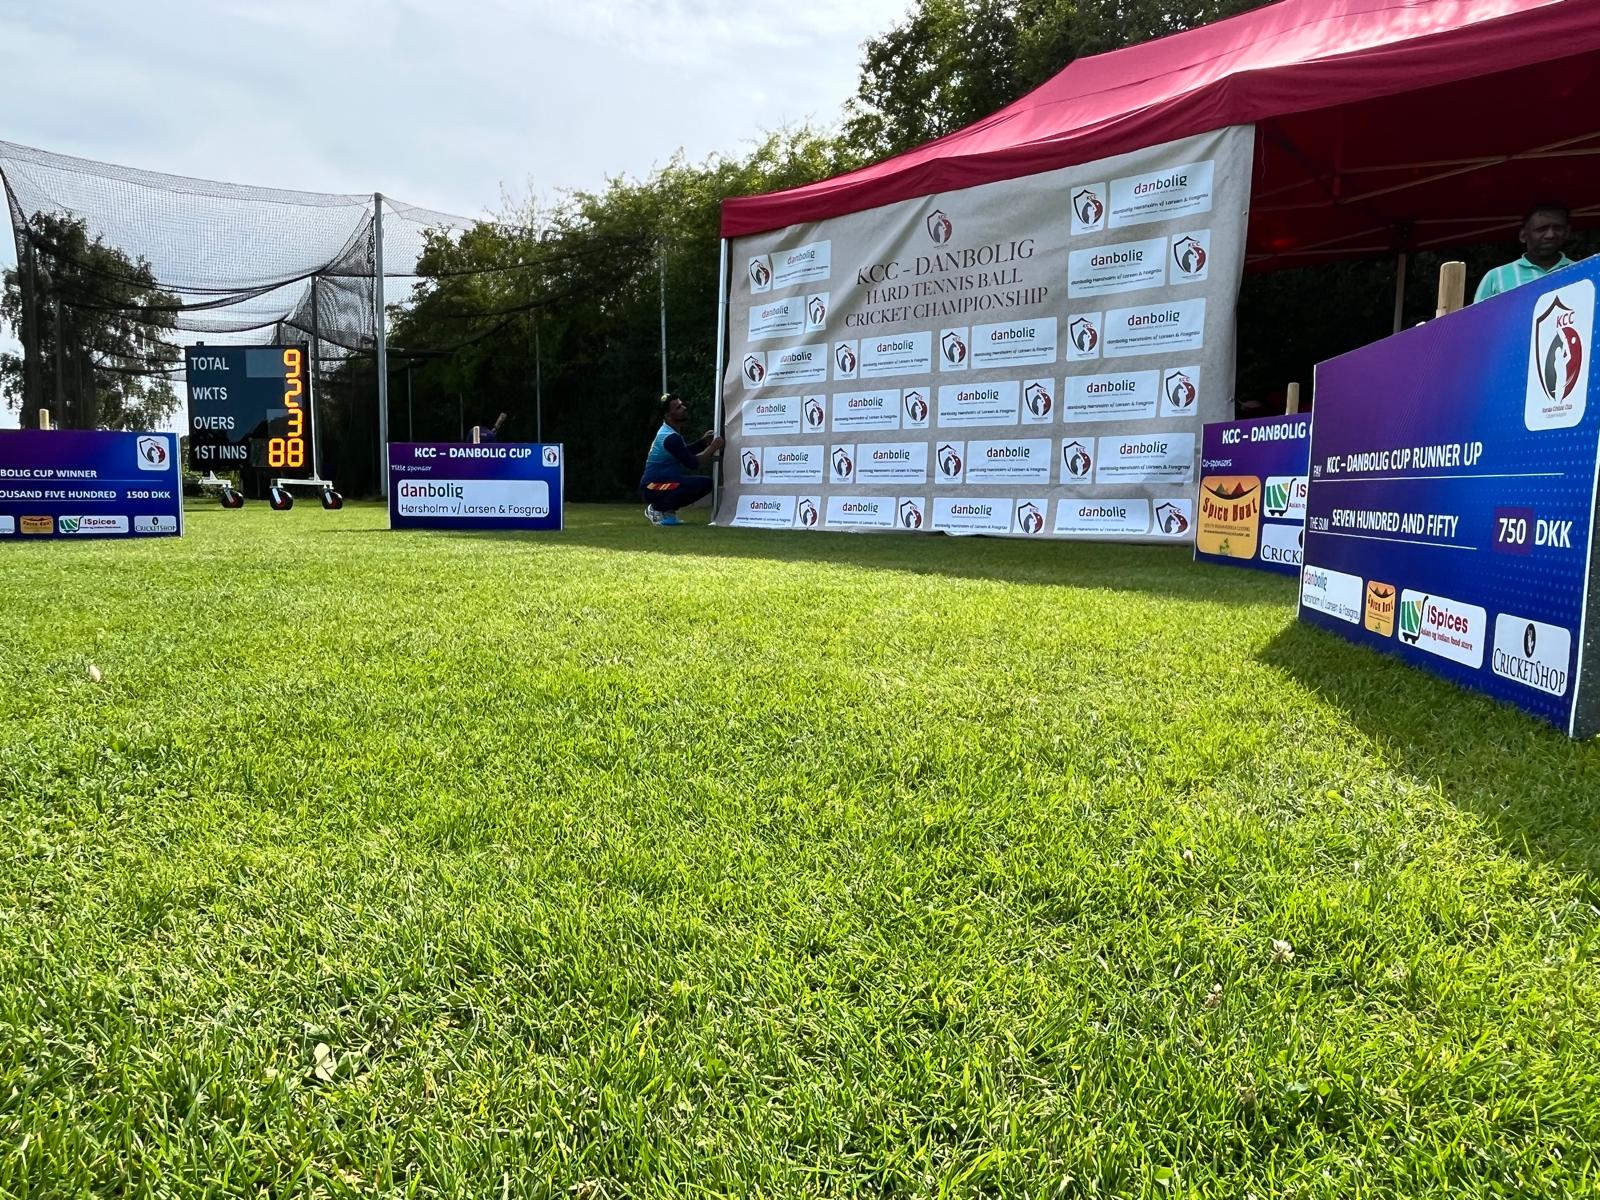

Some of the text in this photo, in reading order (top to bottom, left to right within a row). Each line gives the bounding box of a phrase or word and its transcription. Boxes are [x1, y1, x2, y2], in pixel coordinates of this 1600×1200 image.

[1134, 174, 1188, 195] danbolig
[856, 262, 900, 286] KCC
[915, 239, 1034, 276] DANBOLIG
[1090, 249, 1143, 266] danbolig
[866, 268, 1023, 305] HARD TENNIS BALL
[845, 286, 1048, 328] CRICKET CHAMPIONSHIP
[1128, 310, 1180, 326] danbolig
[1556, 311, 1576, 328] KCC
[991, 327, 1036, 341] danbolig
[876, 340, 914, 352] danbolig
[191, 348, 300, 378] TOTAL 9
[192, 378, 302, 407] WKTS 2
[1086, 380, 1136, 394] danbolig
[957, 389, 999, 401] danbolig
[756, 404, 786, 414] danbolig
[848, 397, 883, 408] danbolig
[194, 408, 302, 437] OVERS 3
[1222, 428, 1240, 444] KCC
[1251, 422, 1306, 442] DANBOLIG
[194, 438, 304, 468] 1ST INNS 88
[414, 448, 436, 458] KCC
[450, 448, 506, 458] DANBOLIG
[509, 448, 532, 458] CUP
[873, 449, 910, 461] danbolig
[986, 446, 1030, 458] danbolig
[1120, 441, 1168, 455] danbolig
[778, 452, 808, 462] danbolig
[1326, 456, 1340, 474] KCC
[1346, 451, 1389, 472] DANBOLIG
[1391, 449, 1410, 469] CUP
[1413, 444, 1460, 468] RUNNER
[1464, 441, 1483, 466] UP
[0, 470, 97, 478] BOLIG CUP WINNER
[0, 490, 42, 498] OUSAND
[44, 490, 66, 498] FIVE
[68, 490, 116, 499] HUNDRED
[400, 483, 464, 499] danbolig
[402, 502, 548, 516] Hørsholm v/ Larsen & Fosgrau
[750, 500, 781, 510] danbolig
[842, 502, 878, 512] danbolig
[951, 504, 992, 516] danbolig
[1078, 506, 1126, 519] danbolig
[1310, 516, 1328, 530] THE SUM
[1332, 508, 1572, 548] SEVEN HUNDRED AND FIFTY 750 DKK
[1304, 568, 1328, 592] danbolig
[1427, 604, 1468, 634] ISpices
[1421, 628, 1432, 637] Asian
